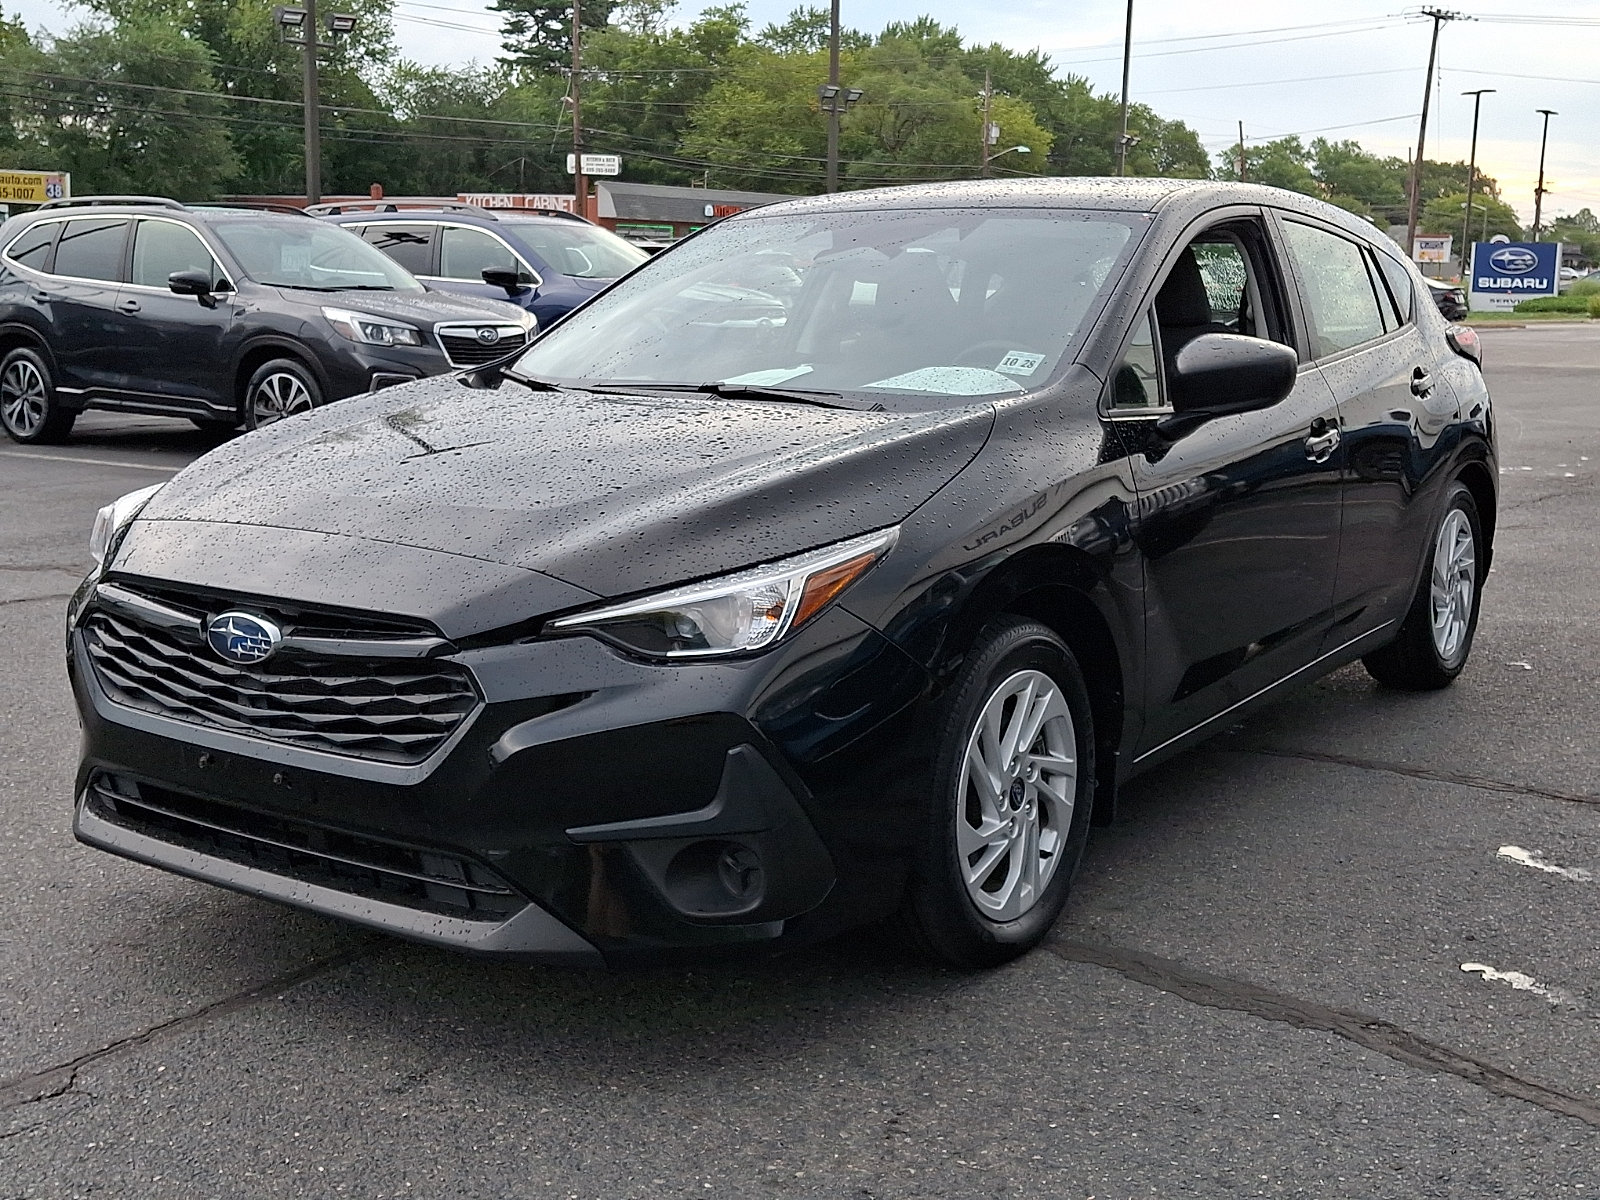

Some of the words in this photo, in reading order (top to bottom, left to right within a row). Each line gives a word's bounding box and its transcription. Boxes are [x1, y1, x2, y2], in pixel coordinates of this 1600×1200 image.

[0, 187, 35, 200] 5-1007
[465, 195, 513, 208] KITCHEN
[524, 196, 574, 213] CABINET
[1478, 277, 1548, 289] SUBARU
[1002, 357, 1019, 367] 10
